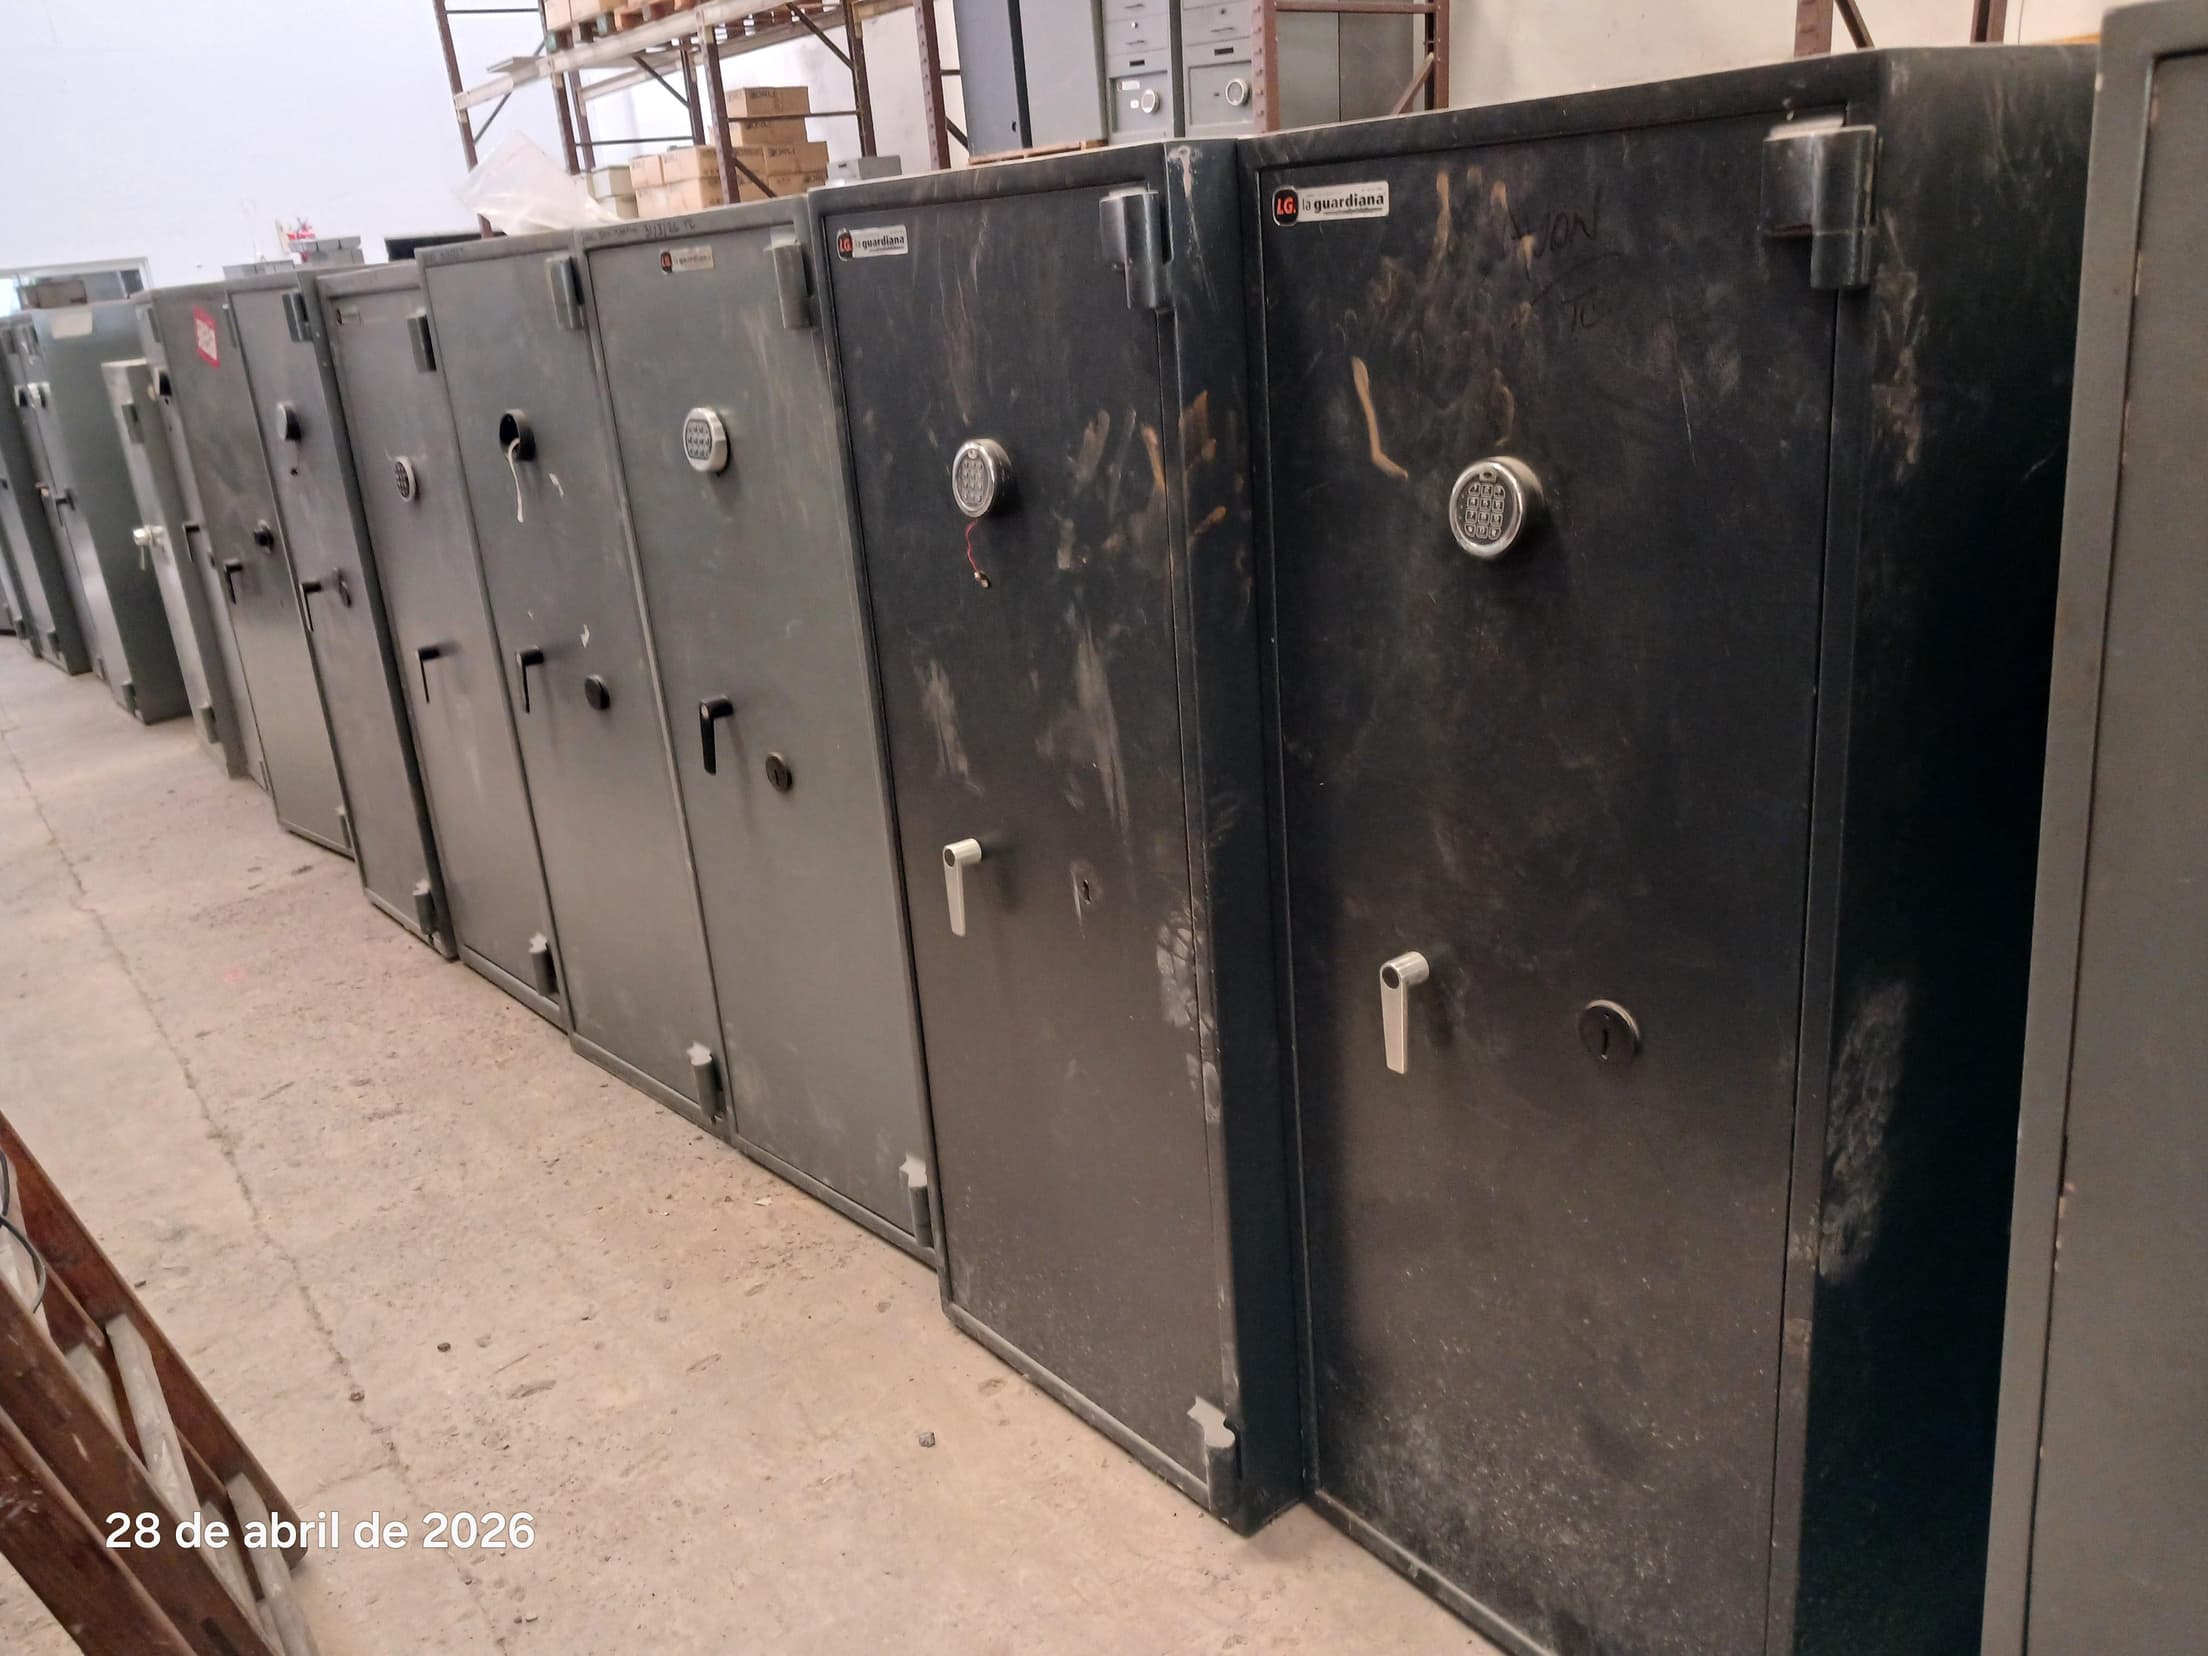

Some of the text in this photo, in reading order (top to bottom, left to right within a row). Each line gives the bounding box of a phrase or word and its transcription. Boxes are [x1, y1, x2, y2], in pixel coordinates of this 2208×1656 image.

[1302, 198, 1311, 211] la
[1314, 193, 1384, 214] guardiana
[862, 235, 905, 249] guardiana
